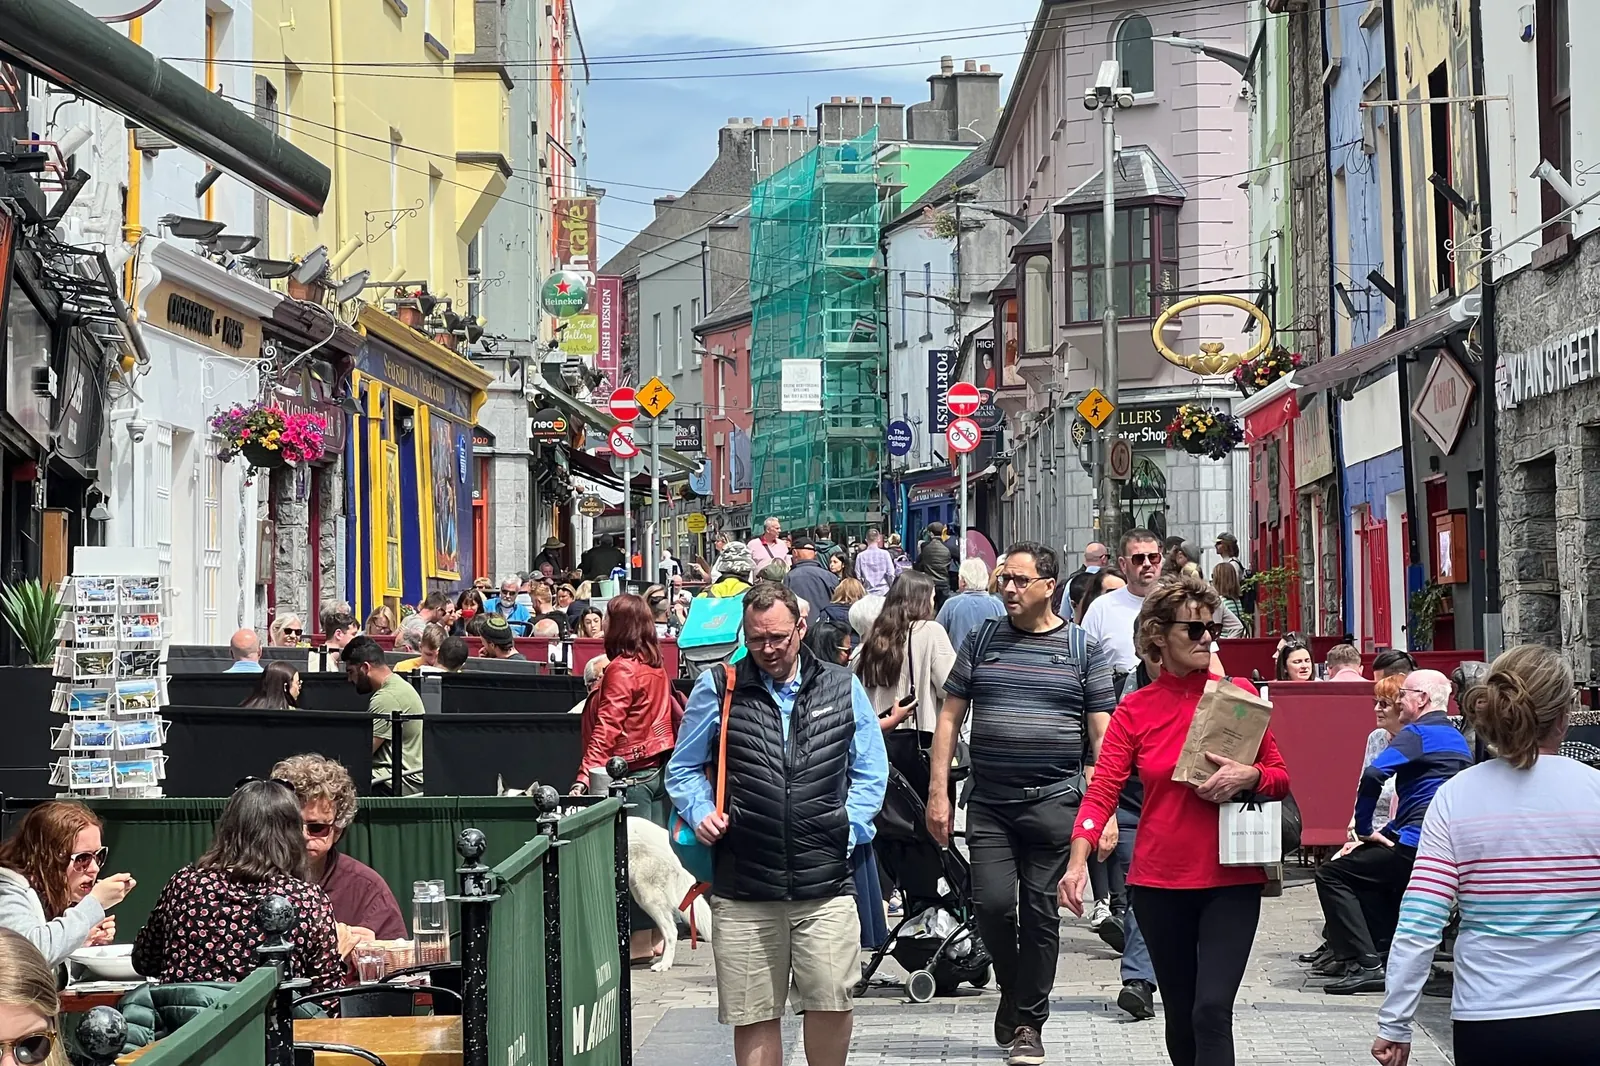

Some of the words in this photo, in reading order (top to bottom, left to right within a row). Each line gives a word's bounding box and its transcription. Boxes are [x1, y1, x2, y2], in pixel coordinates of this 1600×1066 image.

[545, 296, 583, 307] Heineken
[602, 289, 611, 328] DESIGN
[222, 315, 244, 350] PRESS
[580, 319, 596, 330] Food
[563, 330, 592, 344] Gallery
[602, 331, 611, 362] IRISH
[1545, 325, 1595, 394] STREET
[1117, 409, 1162, 425] LLER'S
[1141, 426, 1168, 444] Shop
[891, 440, 907, 449] Shop
